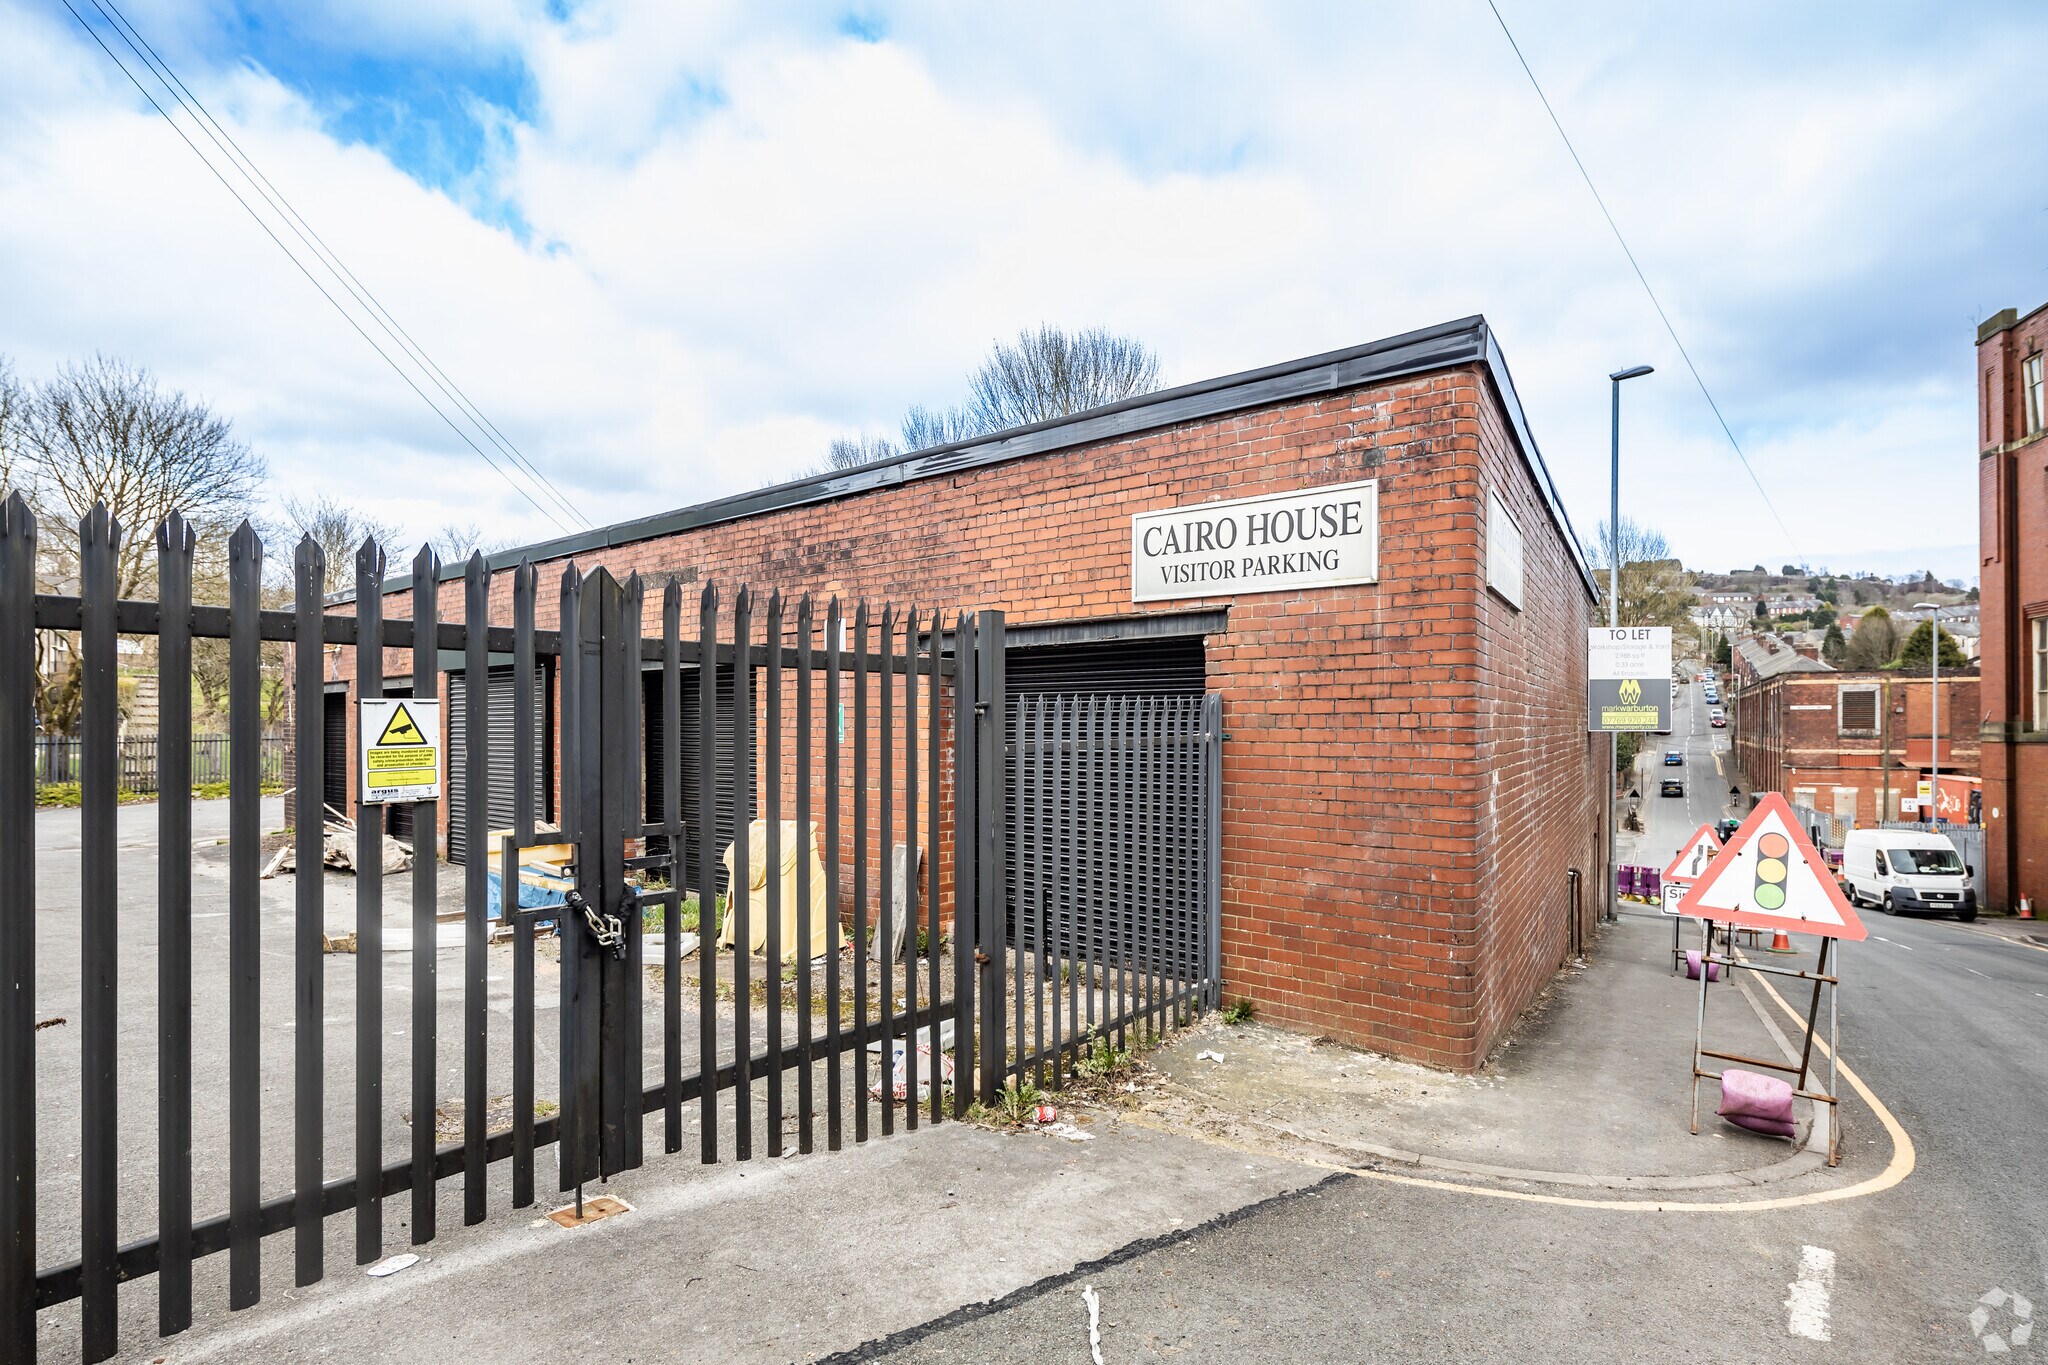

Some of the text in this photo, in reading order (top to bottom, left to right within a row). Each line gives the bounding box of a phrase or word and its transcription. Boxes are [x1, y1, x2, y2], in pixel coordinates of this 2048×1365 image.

[1143, 501, 1363, 557] CAIRO HOUSE
[1161, 549, 1340, 585] VISITOR PARKING
[1609, 629, 1651, 640] TO LET
